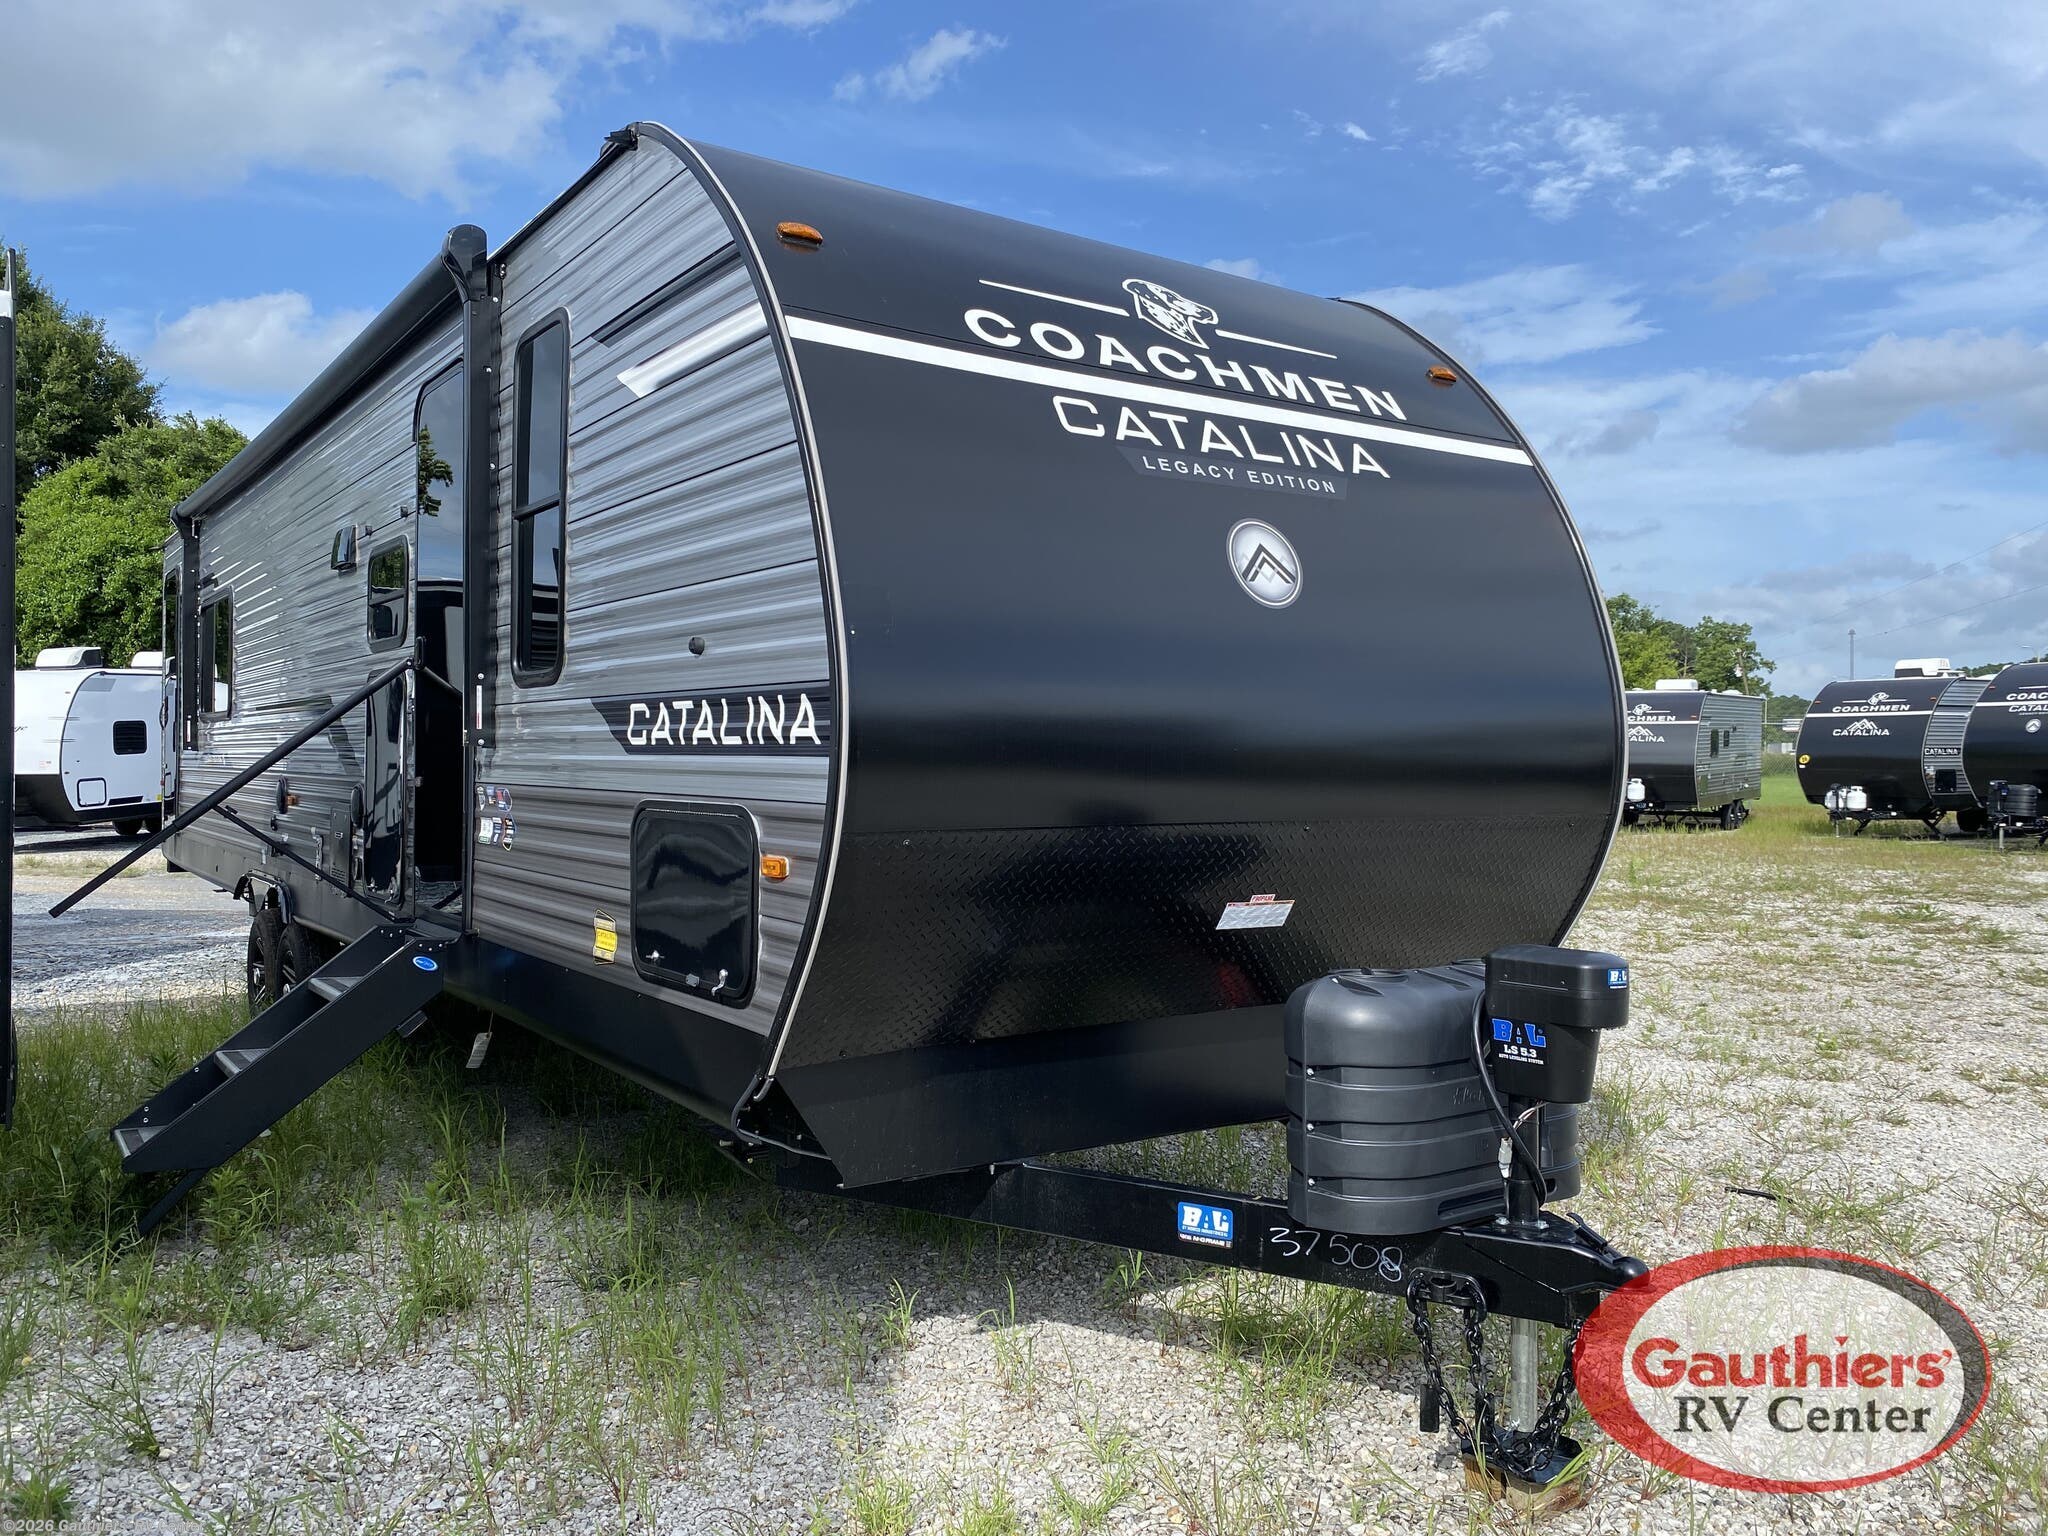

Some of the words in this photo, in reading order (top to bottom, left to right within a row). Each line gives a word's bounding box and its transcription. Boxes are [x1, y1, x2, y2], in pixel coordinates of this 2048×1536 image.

[963, 308, 1407, 421] COACHMEN
[1052, 394, 1391, 479] CATALINA
[1142, 455, 1236, 482] LEGACY
[1248, 469, 1336, 494] EDITION
[627, 693, 822, 745] CATALINA
[1832, 704, 1911, 713] COACHMEN
[1832, 728, 1890, 736] CATALINA
[1492, 1018, 1546, 1048] BAL
[1503, 1044, 1519, 1055] LS
[1520, 1047, 1537, 1058] 5.3
[1182, 1205, 1229, 1232] BAL
[1269, 1227, 1403, 1282] 37508
